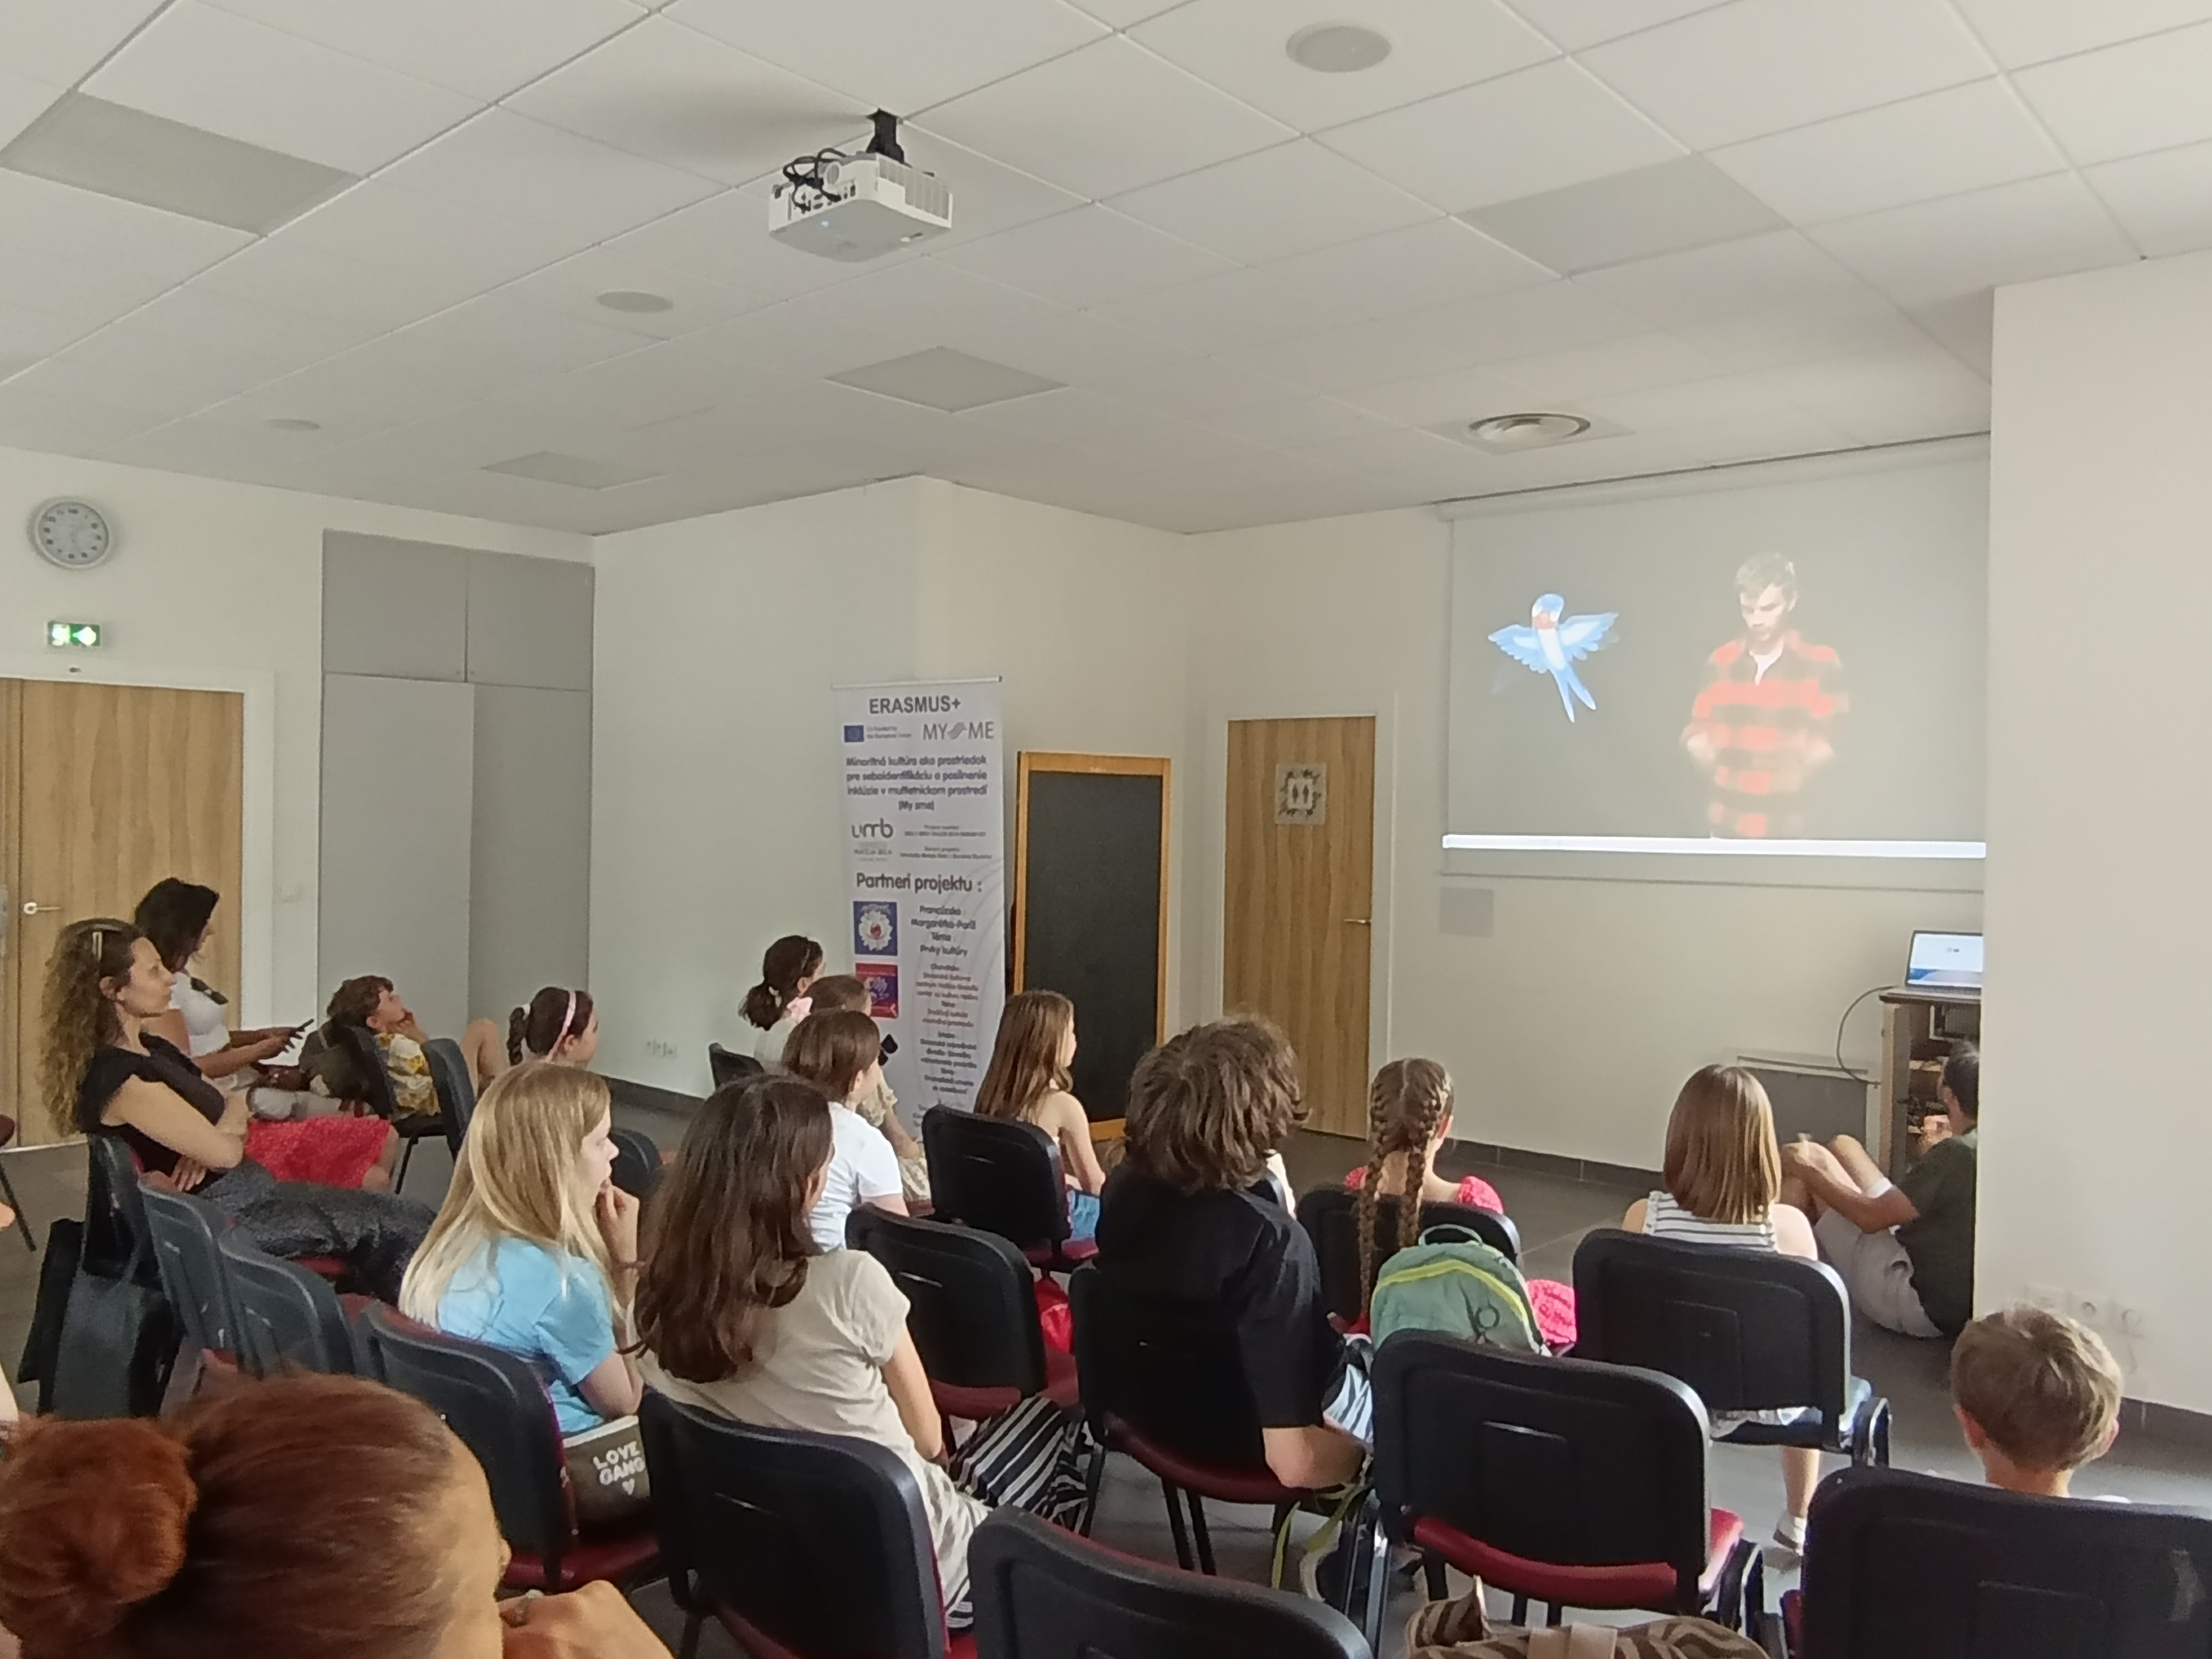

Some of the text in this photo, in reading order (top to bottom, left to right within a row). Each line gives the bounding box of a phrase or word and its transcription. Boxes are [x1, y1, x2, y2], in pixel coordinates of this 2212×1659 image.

[869, 695, 961, 714] ERASMUS+
[923, 721, 994, 740] MY ME
[851, 818, 894, 838] umb
[857, 872, 911, 889] Partneri
[914, 874, 972, 895] projektu
[593, 1441, 640, 1470] LOVE
[599, 1457, 646, 1486] GANG
